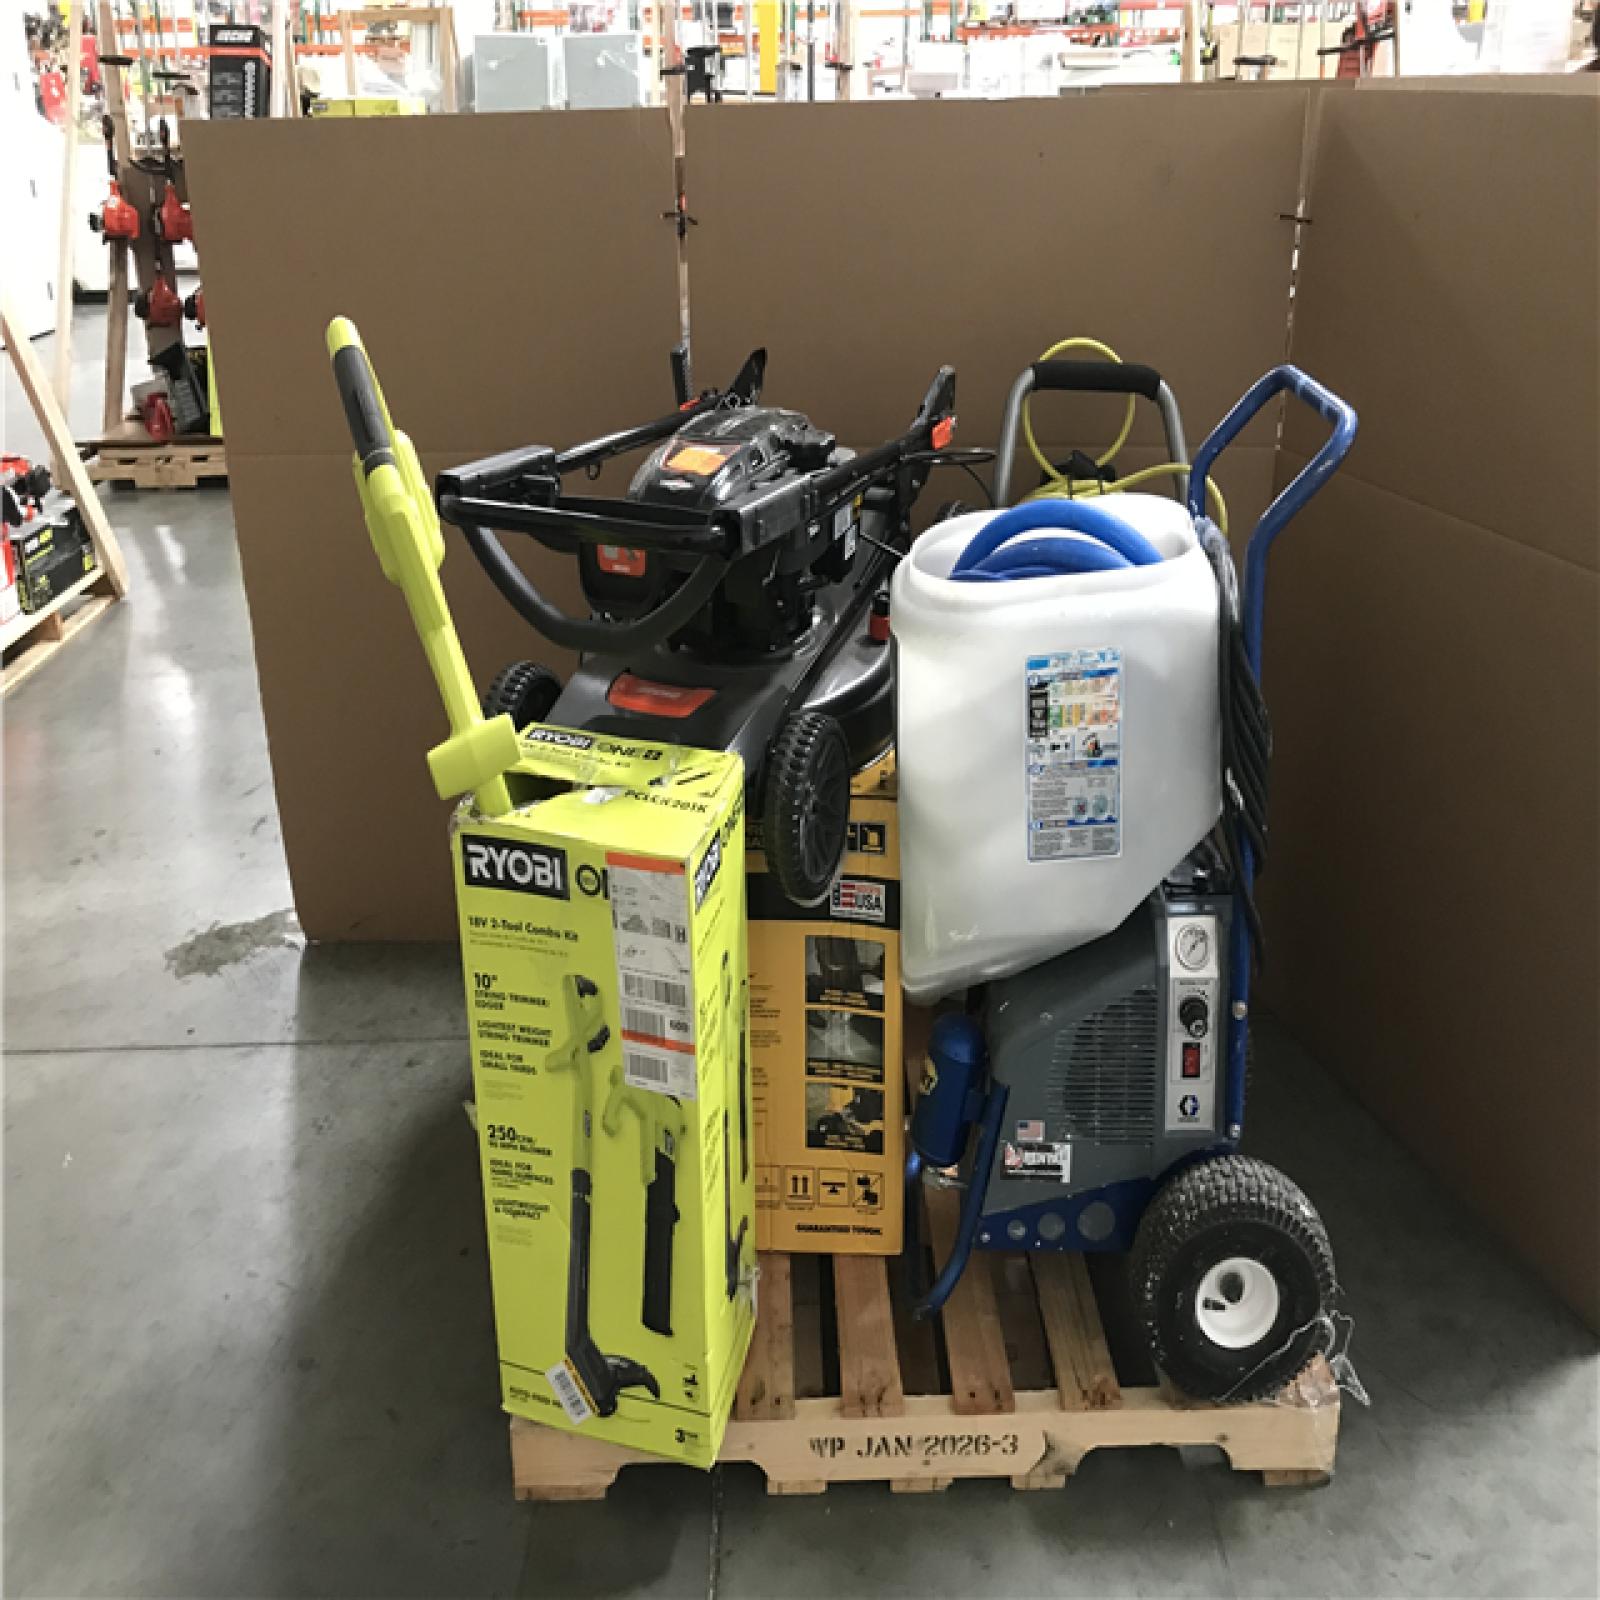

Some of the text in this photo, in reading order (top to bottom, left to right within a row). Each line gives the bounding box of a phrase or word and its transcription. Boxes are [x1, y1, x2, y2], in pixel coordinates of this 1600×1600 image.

[464, 842, 563, 892] RYOBI
[574, 863, 609, 901] O
[468, 915, 488, 928] 18V
[490, 917, 523, 932] 2-Tool
[525, 922, 561, 939] Combo
[564, 929, 578, 943] Kit
[473, 972, 498, 990] 10"
[487, 1124, 516, 1141] 250
[808, 1434, 1019, 1458] WP JAN 2026-3
